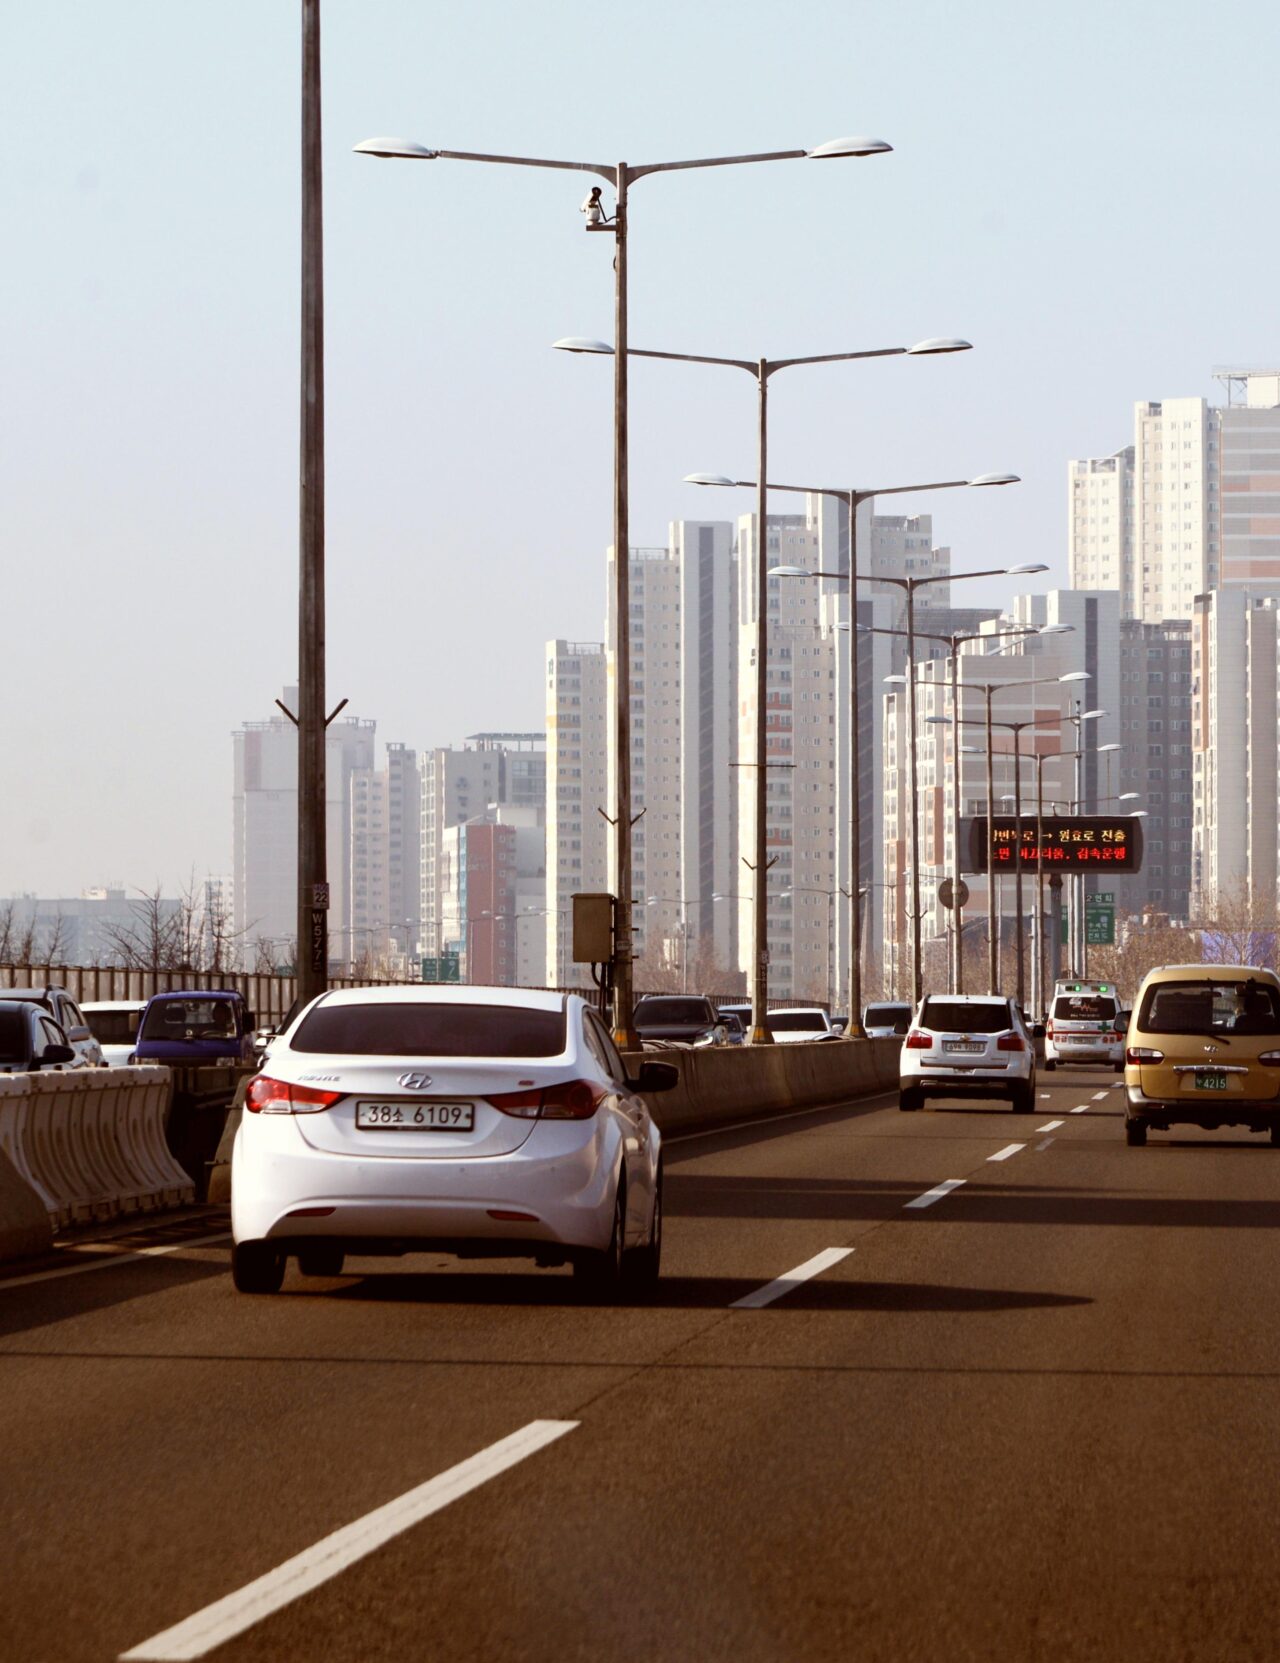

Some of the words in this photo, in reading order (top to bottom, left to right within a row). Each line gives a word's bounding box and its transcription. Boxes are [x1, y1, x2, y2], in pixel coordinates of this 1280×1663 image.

[1059, 829, 1095, 842] 원효로
[1101, 829, 1127, 842] 진출
[1077, 847, 1127, 860] 감속운행
[315, 892, 327, 903] 22
[1203, 1078, 1226, 1089] 4215
[368, 1106, 403, 1122] 38소
[413, 1107, 462, 1124] 6109
